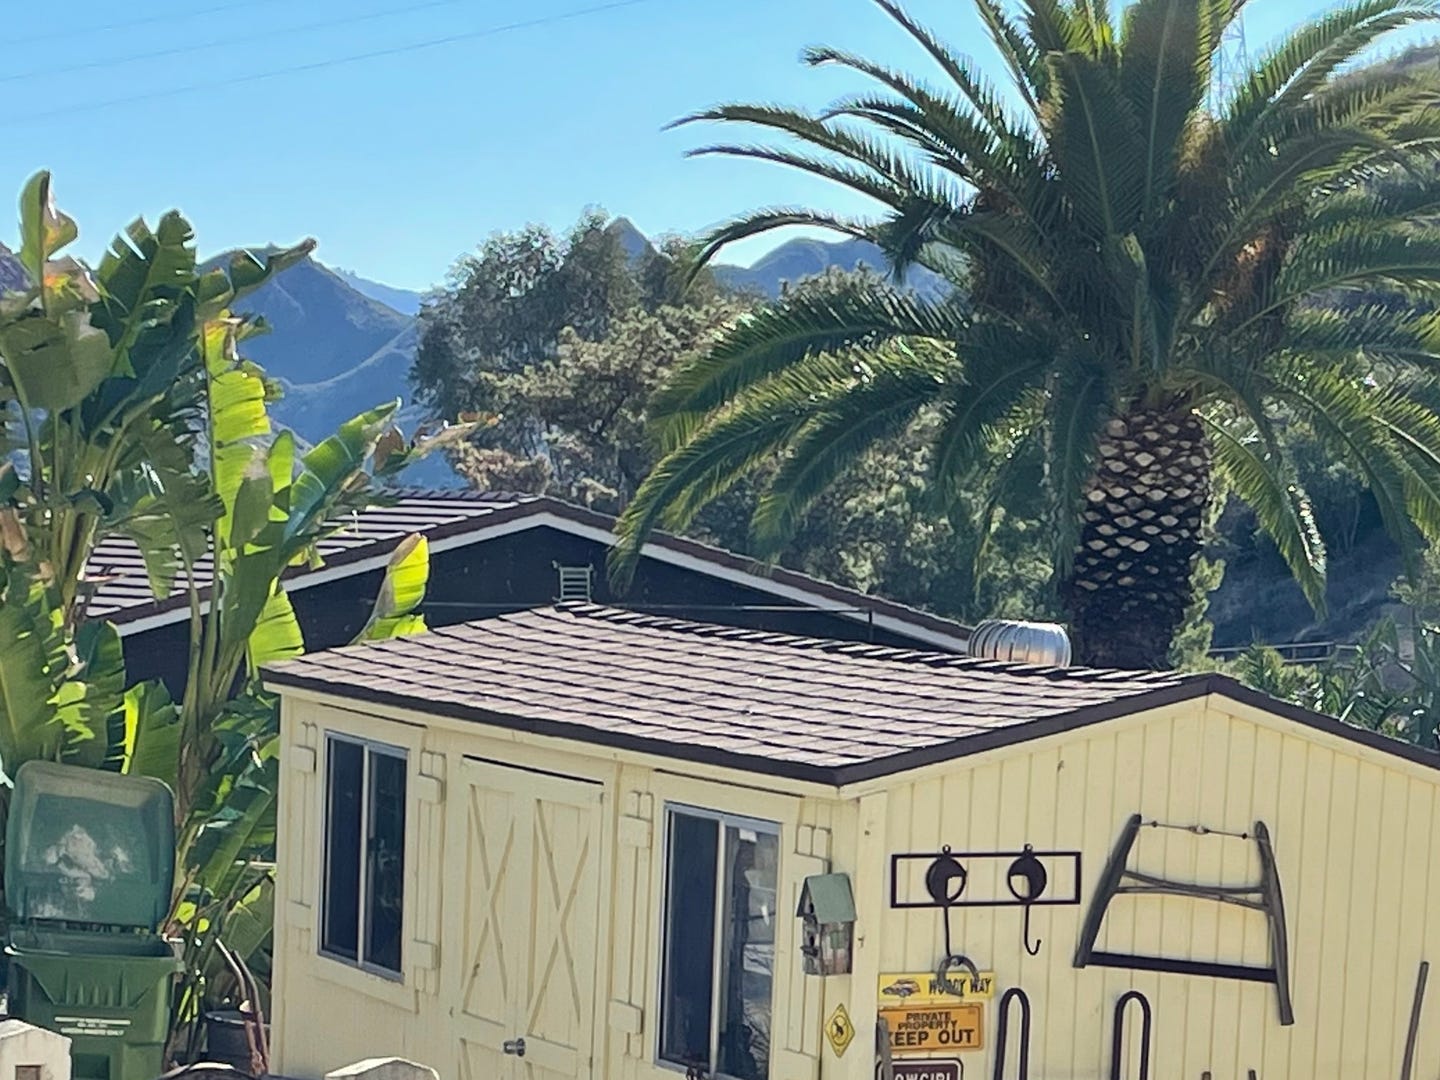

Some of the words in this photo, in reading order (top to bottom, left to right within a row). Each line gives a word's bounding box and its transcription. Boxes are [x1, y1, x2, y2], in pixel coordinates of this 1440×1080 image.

[929, 979, 966, 995] WODY
[970, 977, 992, 994] WAY
[906, 1011, 952, 1021] PRIVATE
[897, 1020, 958, 1030] PROPERTY
[938, 1029, 975, 1044] OUT
